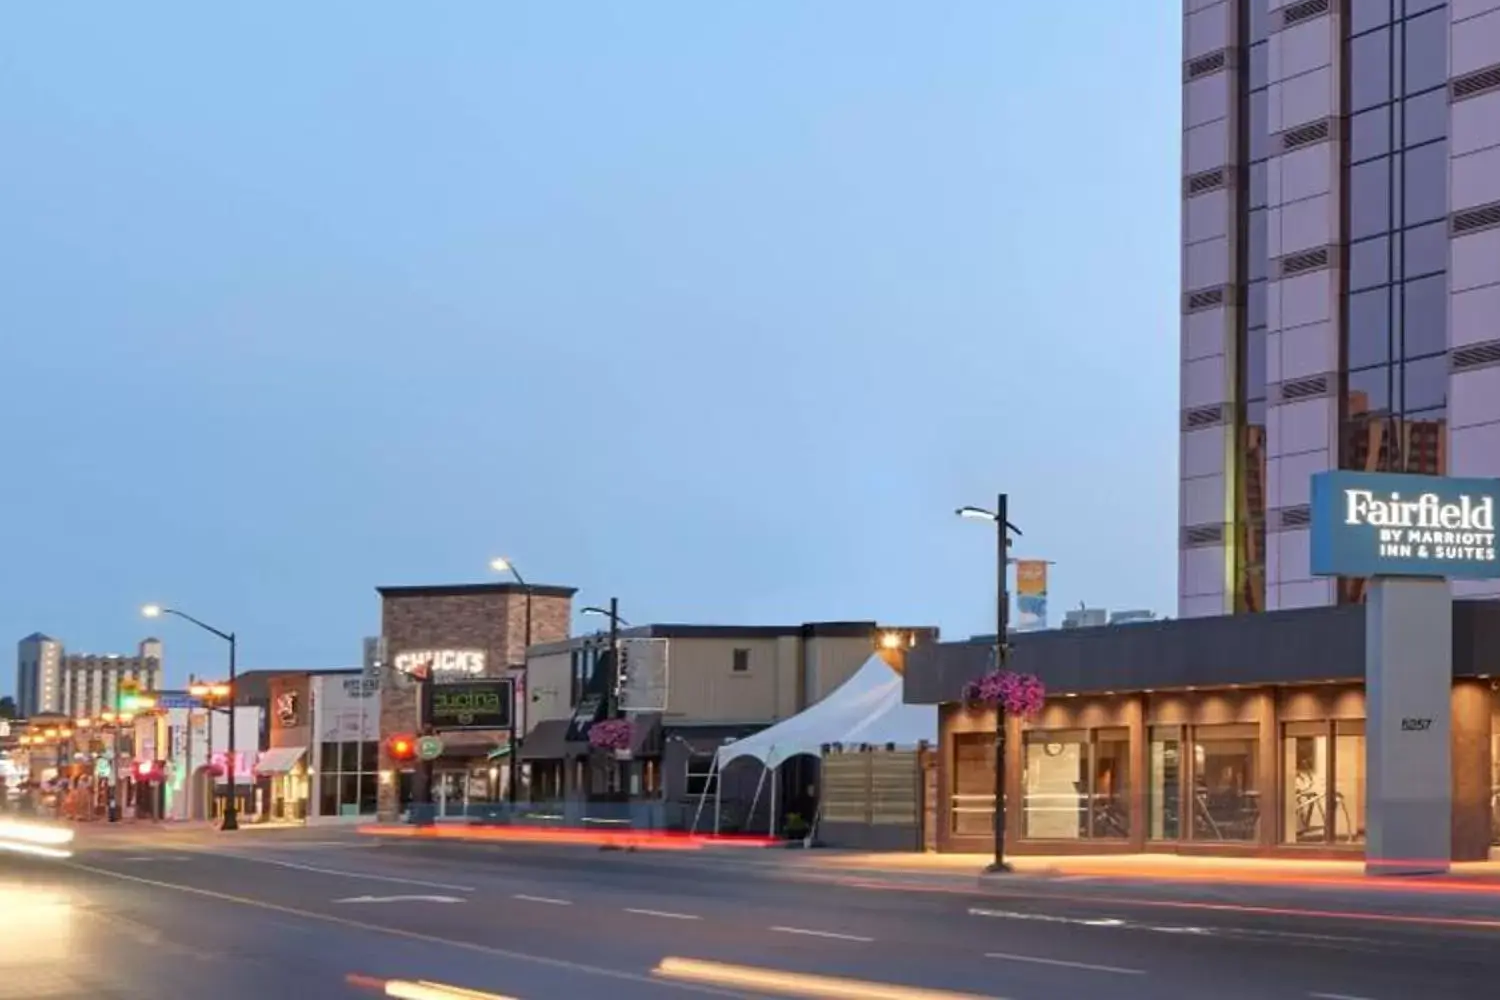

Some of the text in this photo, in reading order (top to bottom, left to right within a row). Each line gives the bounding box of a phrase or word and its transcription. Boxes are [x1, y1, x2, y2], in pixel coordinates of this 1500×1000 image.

[1344, 488, 1494, 531] Fairfield
[1379, 528, 1496, 546] BY MARRIOTT
[1379, 544, 1496, 561] INN & SUITES
